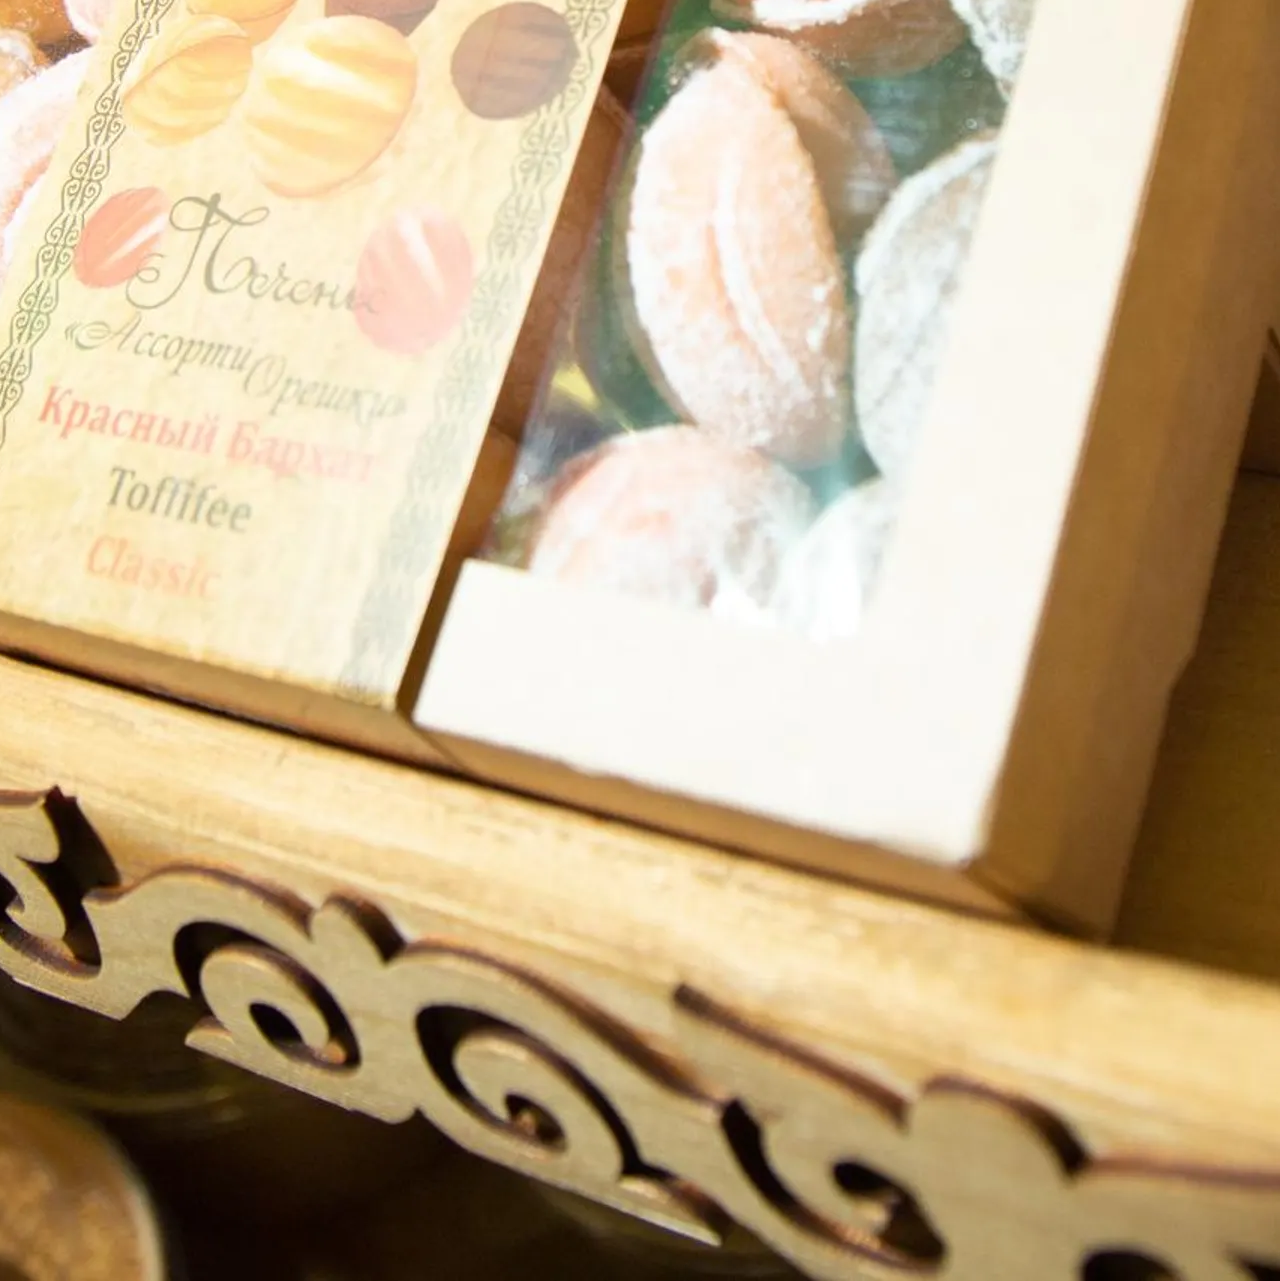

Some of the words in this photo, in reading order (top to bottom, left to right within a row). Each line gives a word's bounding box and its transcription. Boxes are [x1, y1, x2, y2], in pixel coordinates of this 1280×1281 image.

[37, 384, 220, 456] Красный
[226, 420, 378, 484] Бархат
[85, 534, 222, 601] Classic
